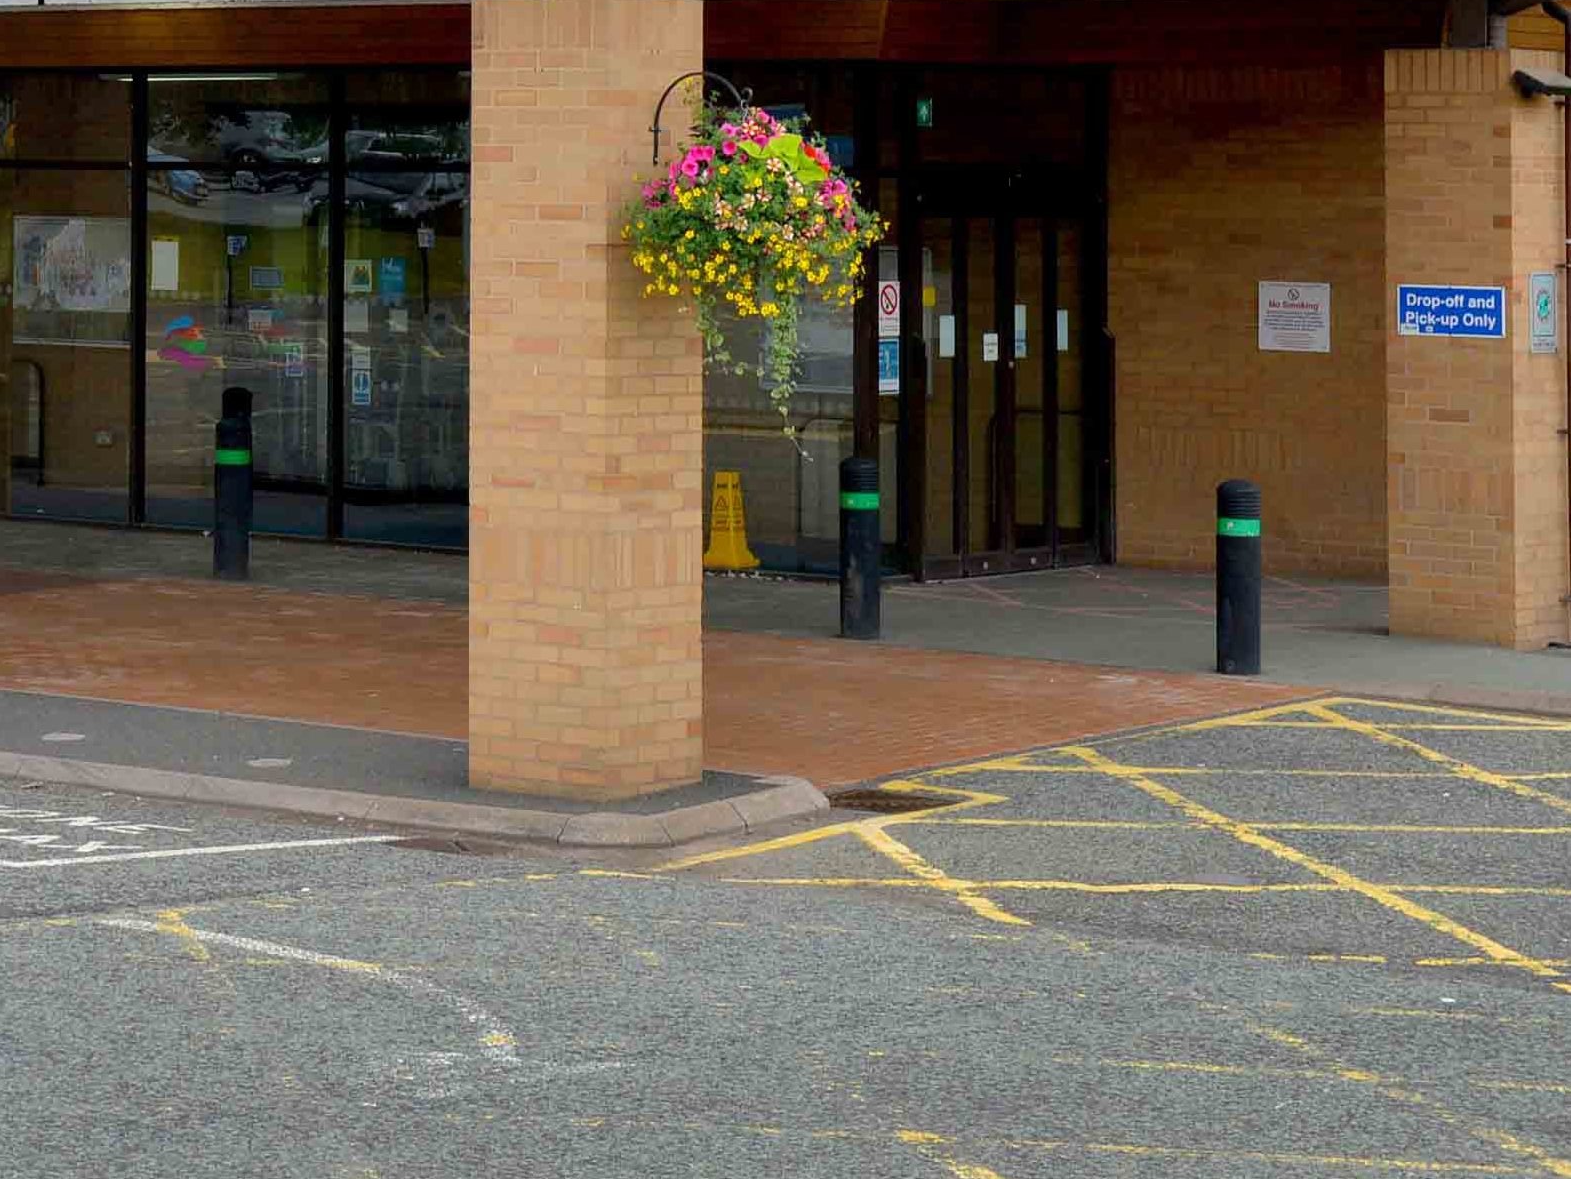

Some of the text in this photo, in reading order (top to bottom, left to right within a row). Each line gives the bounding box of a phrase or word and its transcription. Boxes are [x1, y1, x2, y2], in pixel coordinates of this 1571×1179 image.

[1406, 293, 1496, 310] Drop-off and
[1405, 311, 1496, 331] Pick-up Only
